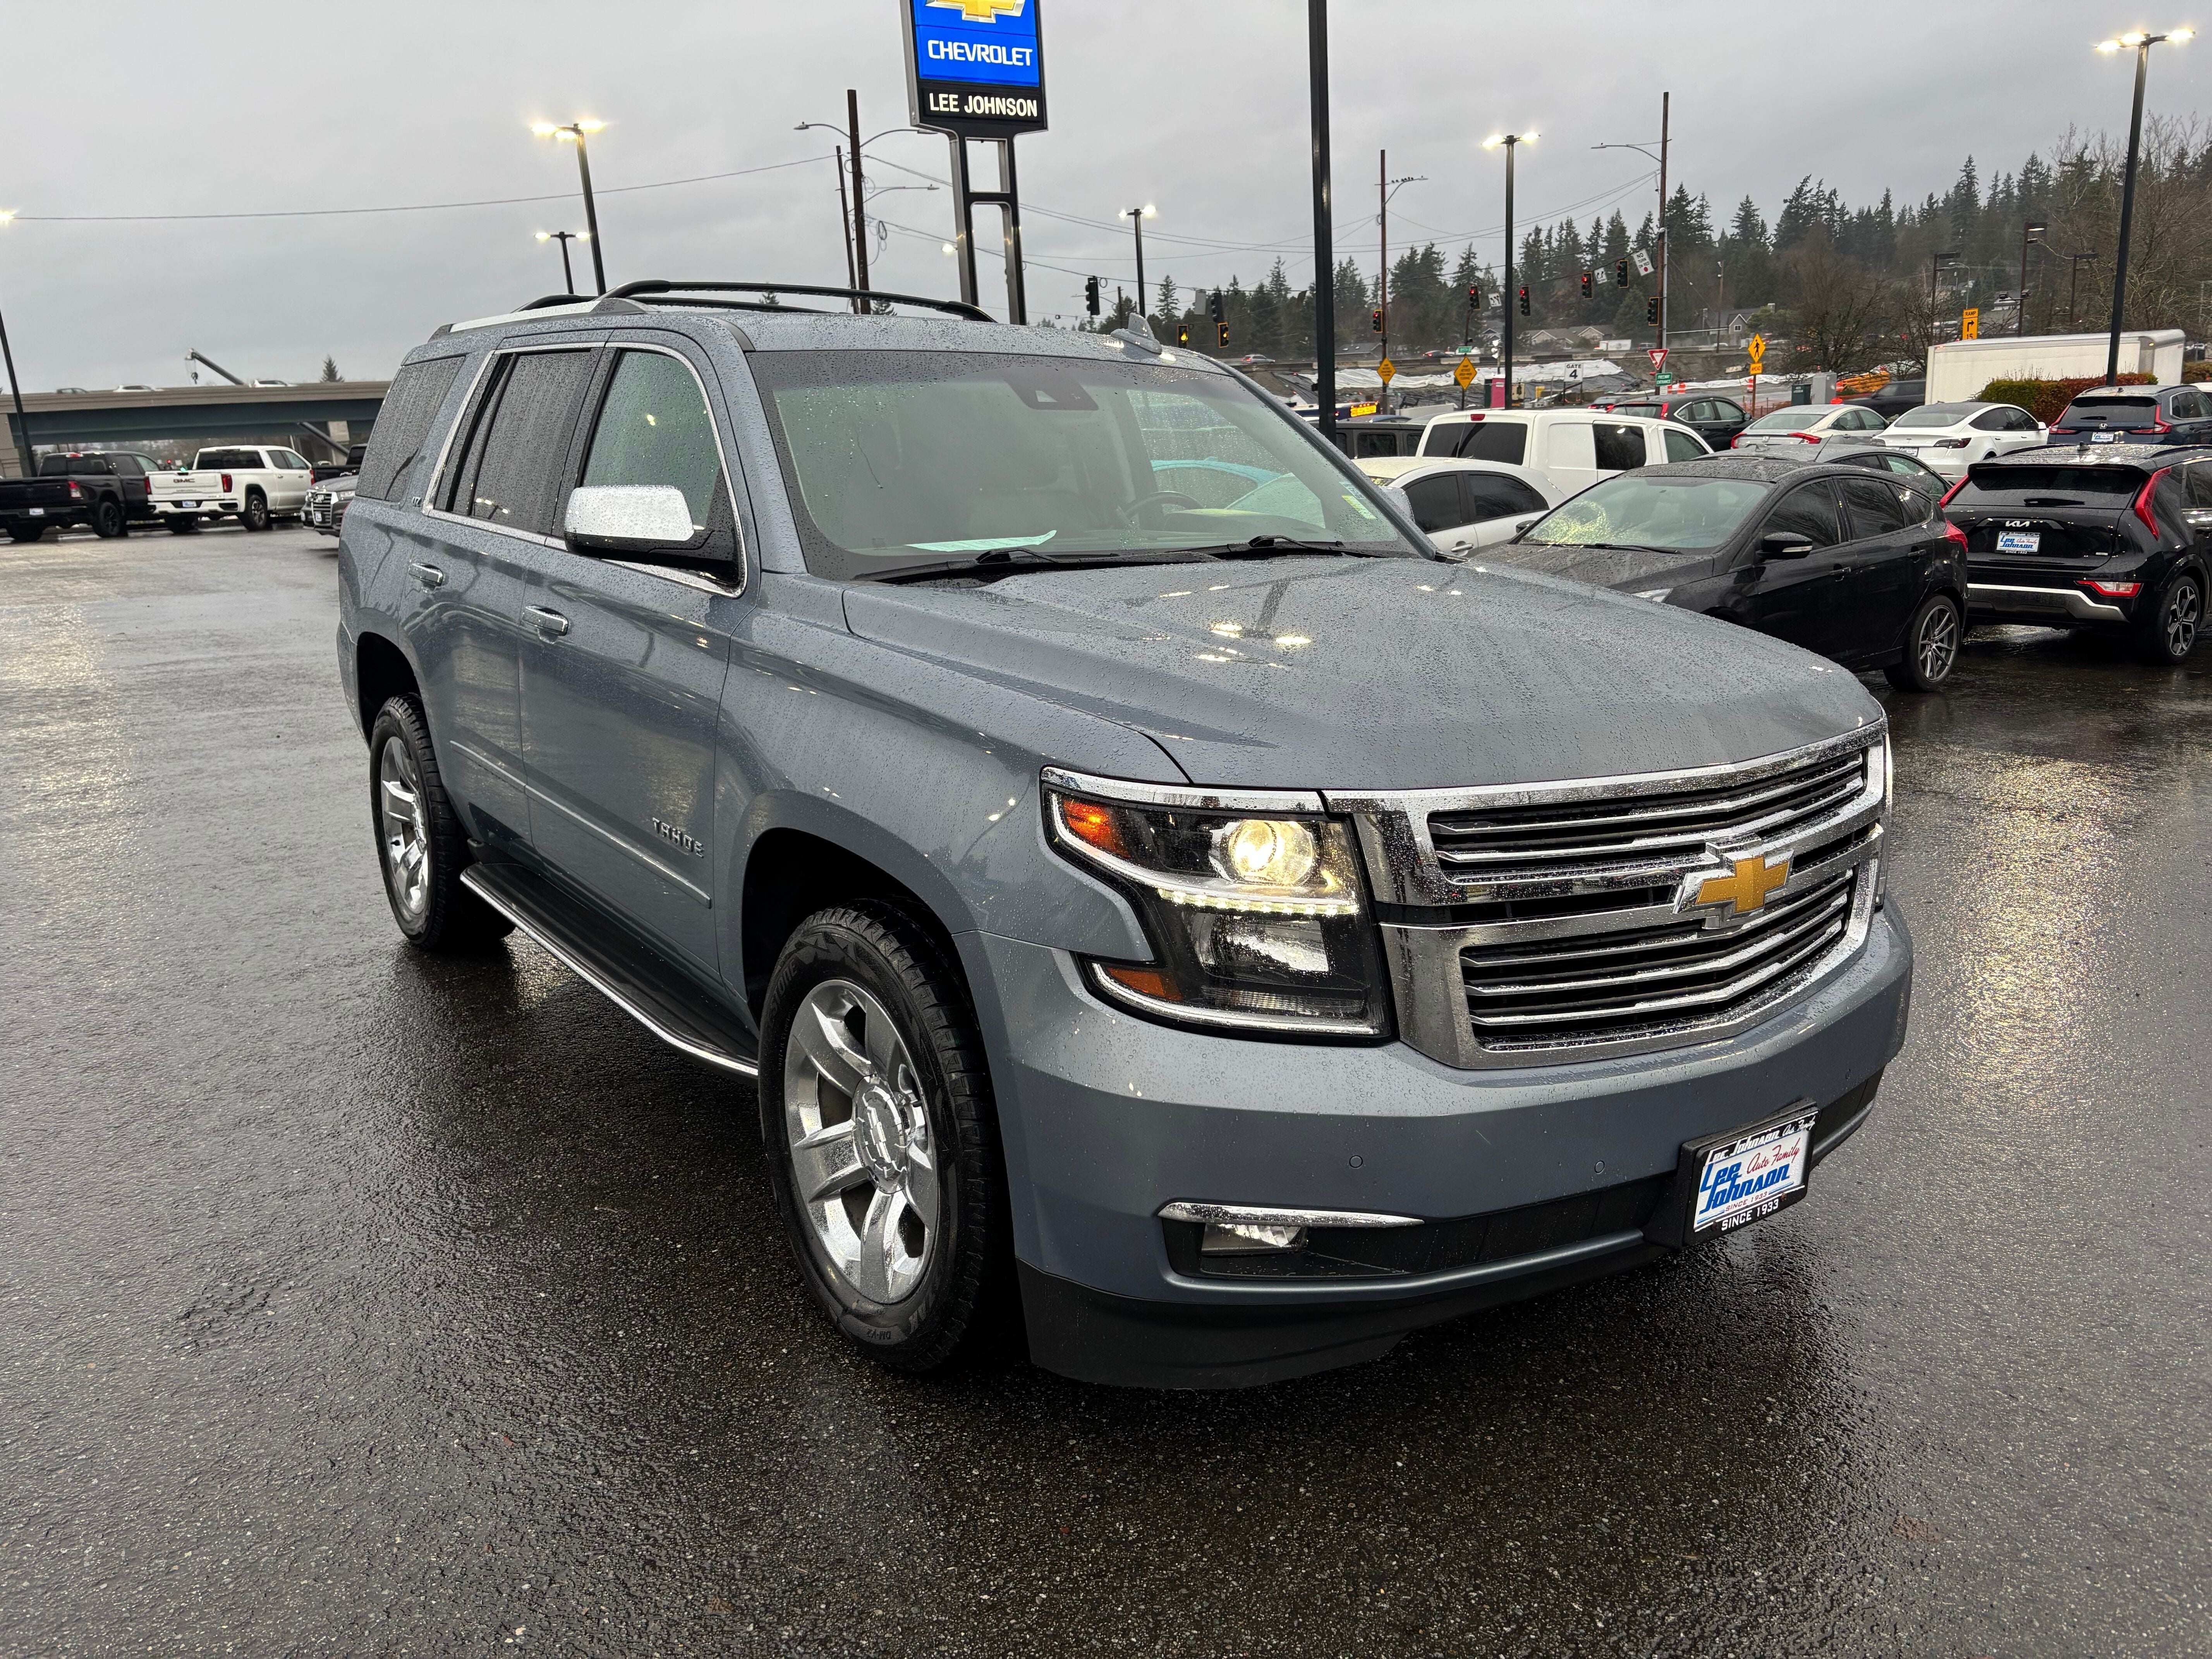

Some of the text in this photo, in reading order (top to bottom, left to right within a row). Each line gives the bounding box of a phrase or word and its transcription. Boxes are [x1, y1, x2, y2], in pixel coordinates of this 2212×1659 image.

[927, 40, 1033, 66] CHEVROLET
[929, 93, 1037, 117] LEE JOHNSON
[1569, 369, 1578, 379] 4
[652, 817, 704, 858] TAHOE
[1729, 1130, 1780, 1156] Johnson
[1700, 1137, 1801, 1193] Lee Auto Family
[1699, 1163, 1791, 1215] Johnson
[1725, 1191, 1768, 1212] SINCE 1933
[1721, 1198, 1779, 1231] SINCE 1933
